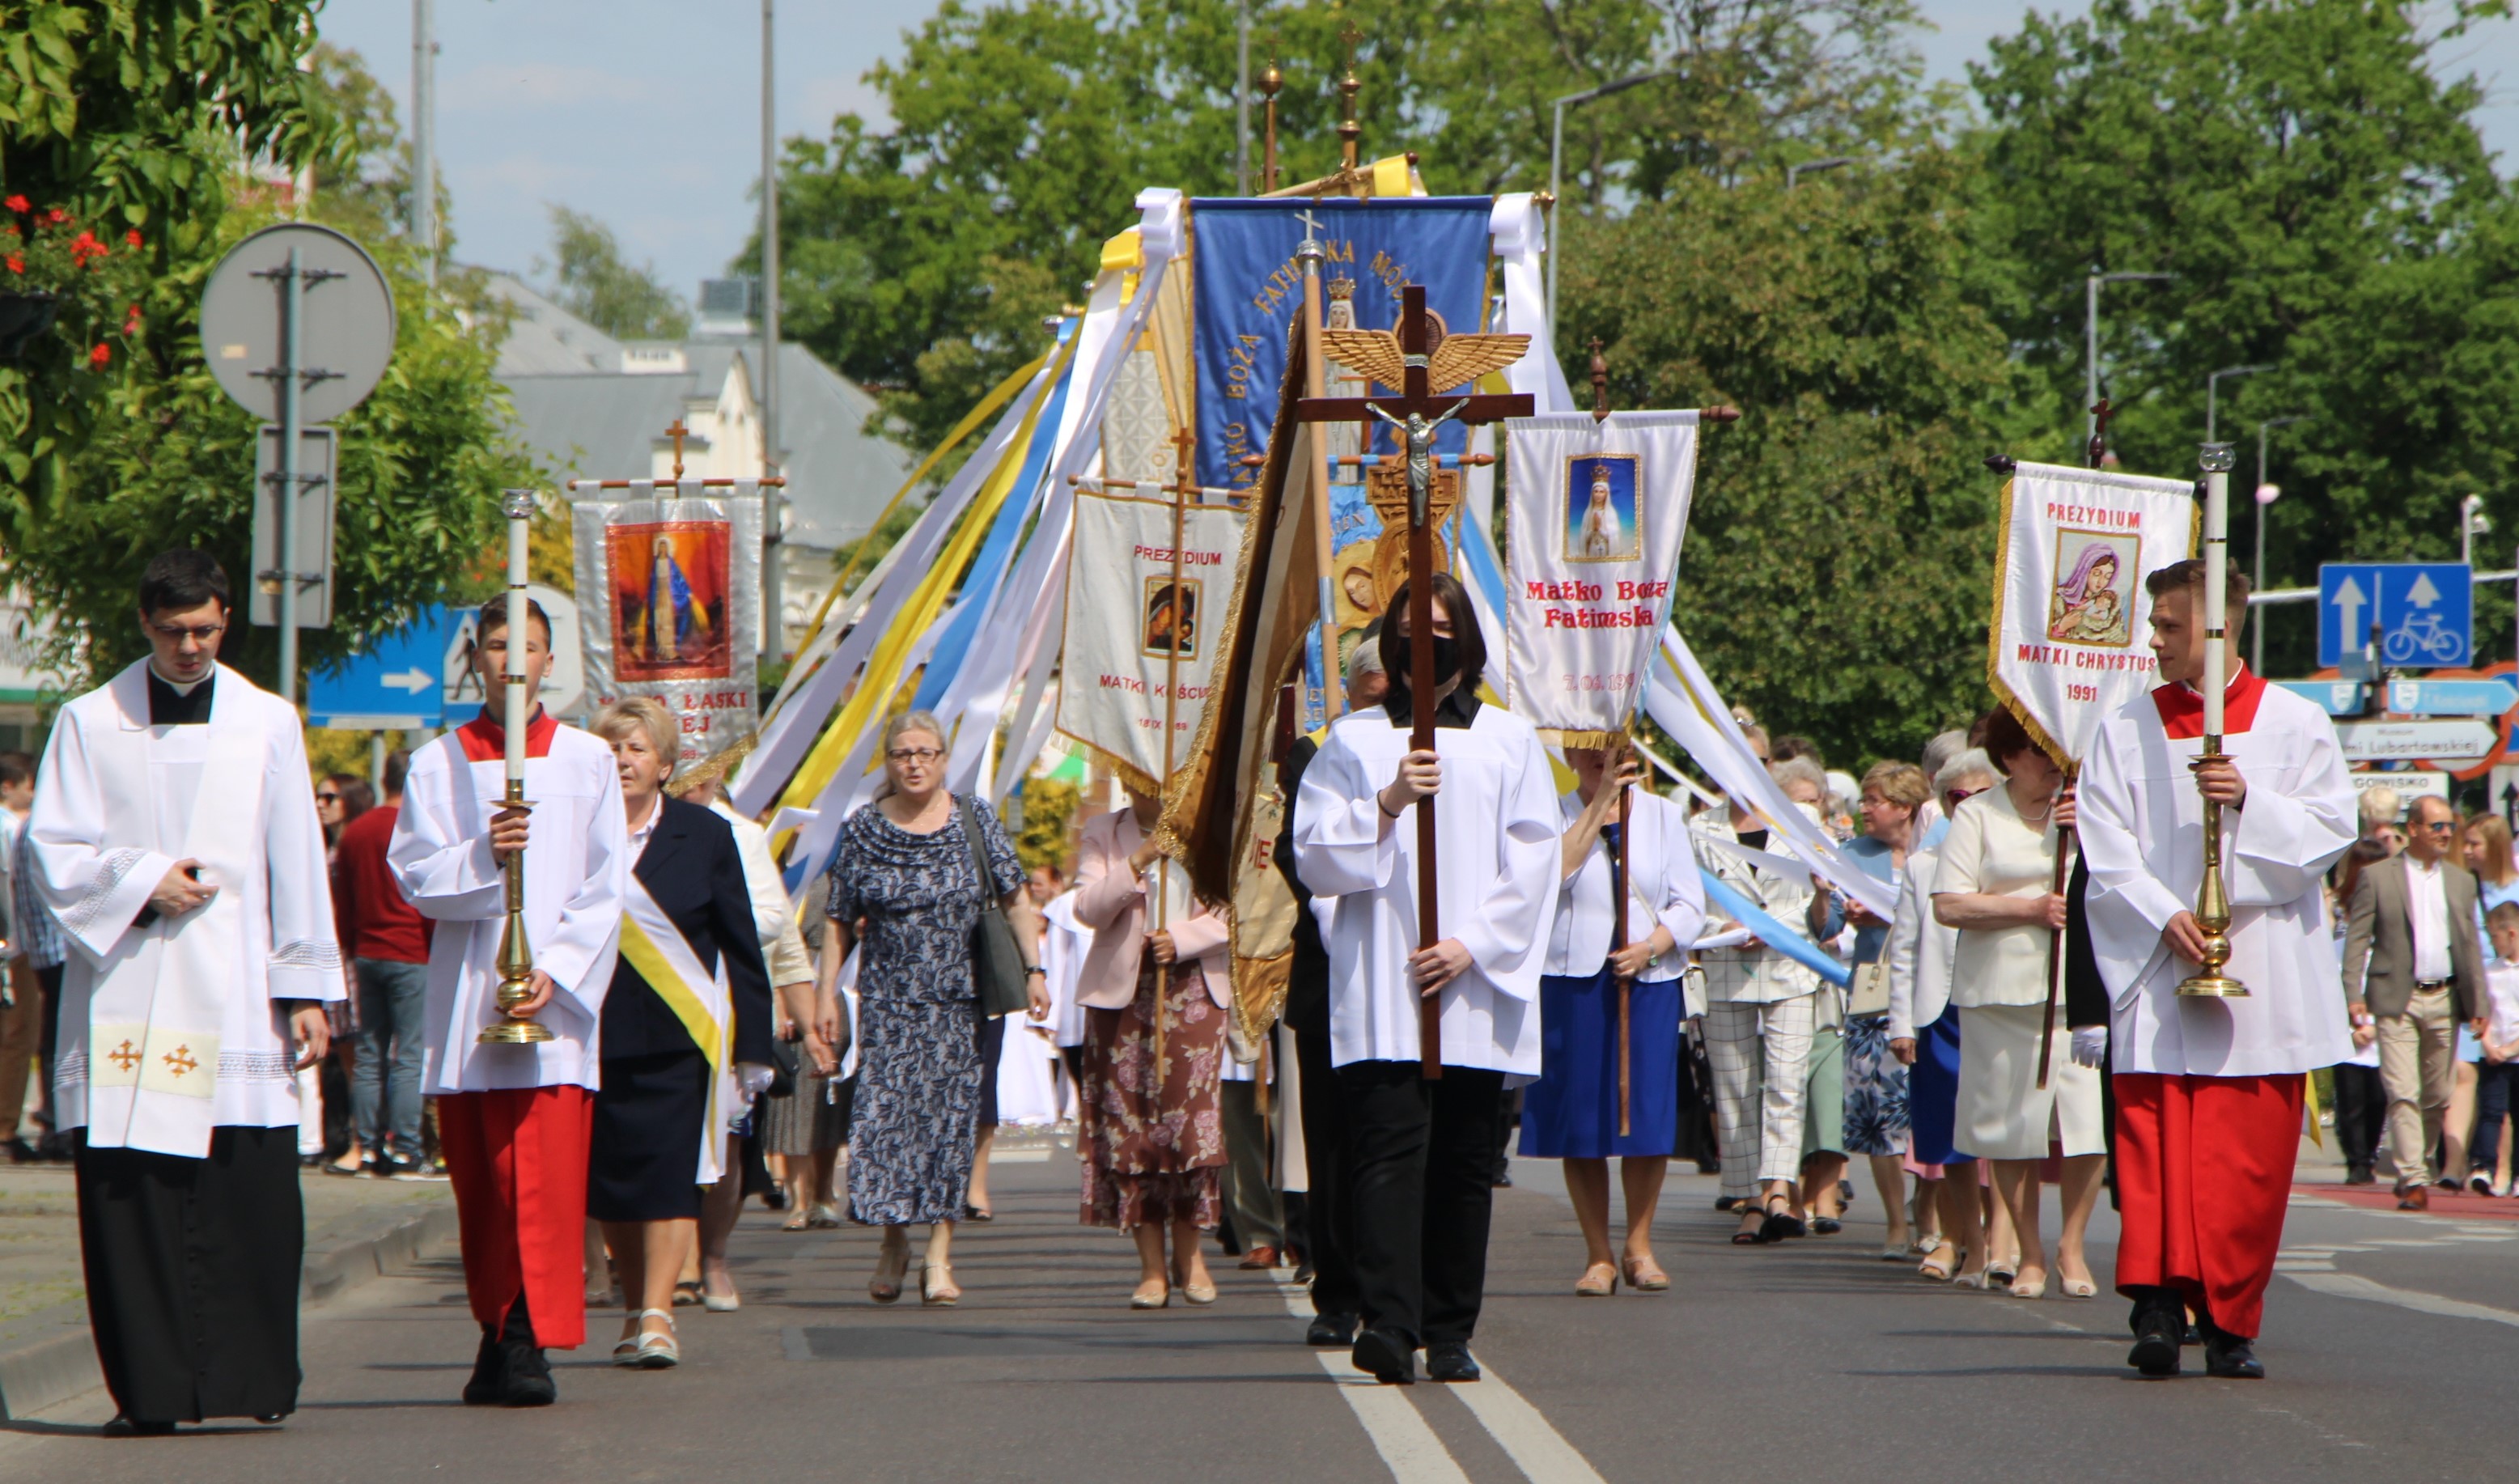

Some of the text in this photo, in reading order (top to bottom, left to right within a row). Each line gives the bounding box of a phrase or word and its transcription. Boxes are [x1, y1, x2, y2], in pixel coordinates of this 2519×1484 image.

[1225, 335, 1261, 399] BOŻA
[1253, 240, 1355, 315] FATIKA
[1369, 250, 1411, 306] MÓD
[2047, 502, 2141, 529] PREZYDIUM
[1134, 545, 1222, 565] PREZDIUM
[1525, 580, 1602, 601] Matko
[1544, 605, 1654, 629] Fatimska
[2018, 644, 2157, 672] MATKI CHRYSTUS
[1100, 674, 1147, 694] MATKI
[2067, 684, 2098, 702] 1991
[684, 691, 747, 710] ŁASKI
[2369, 737, 2479, 755] Lubartowskiej
[2353, 776, 2429, 790] GOWISKO
